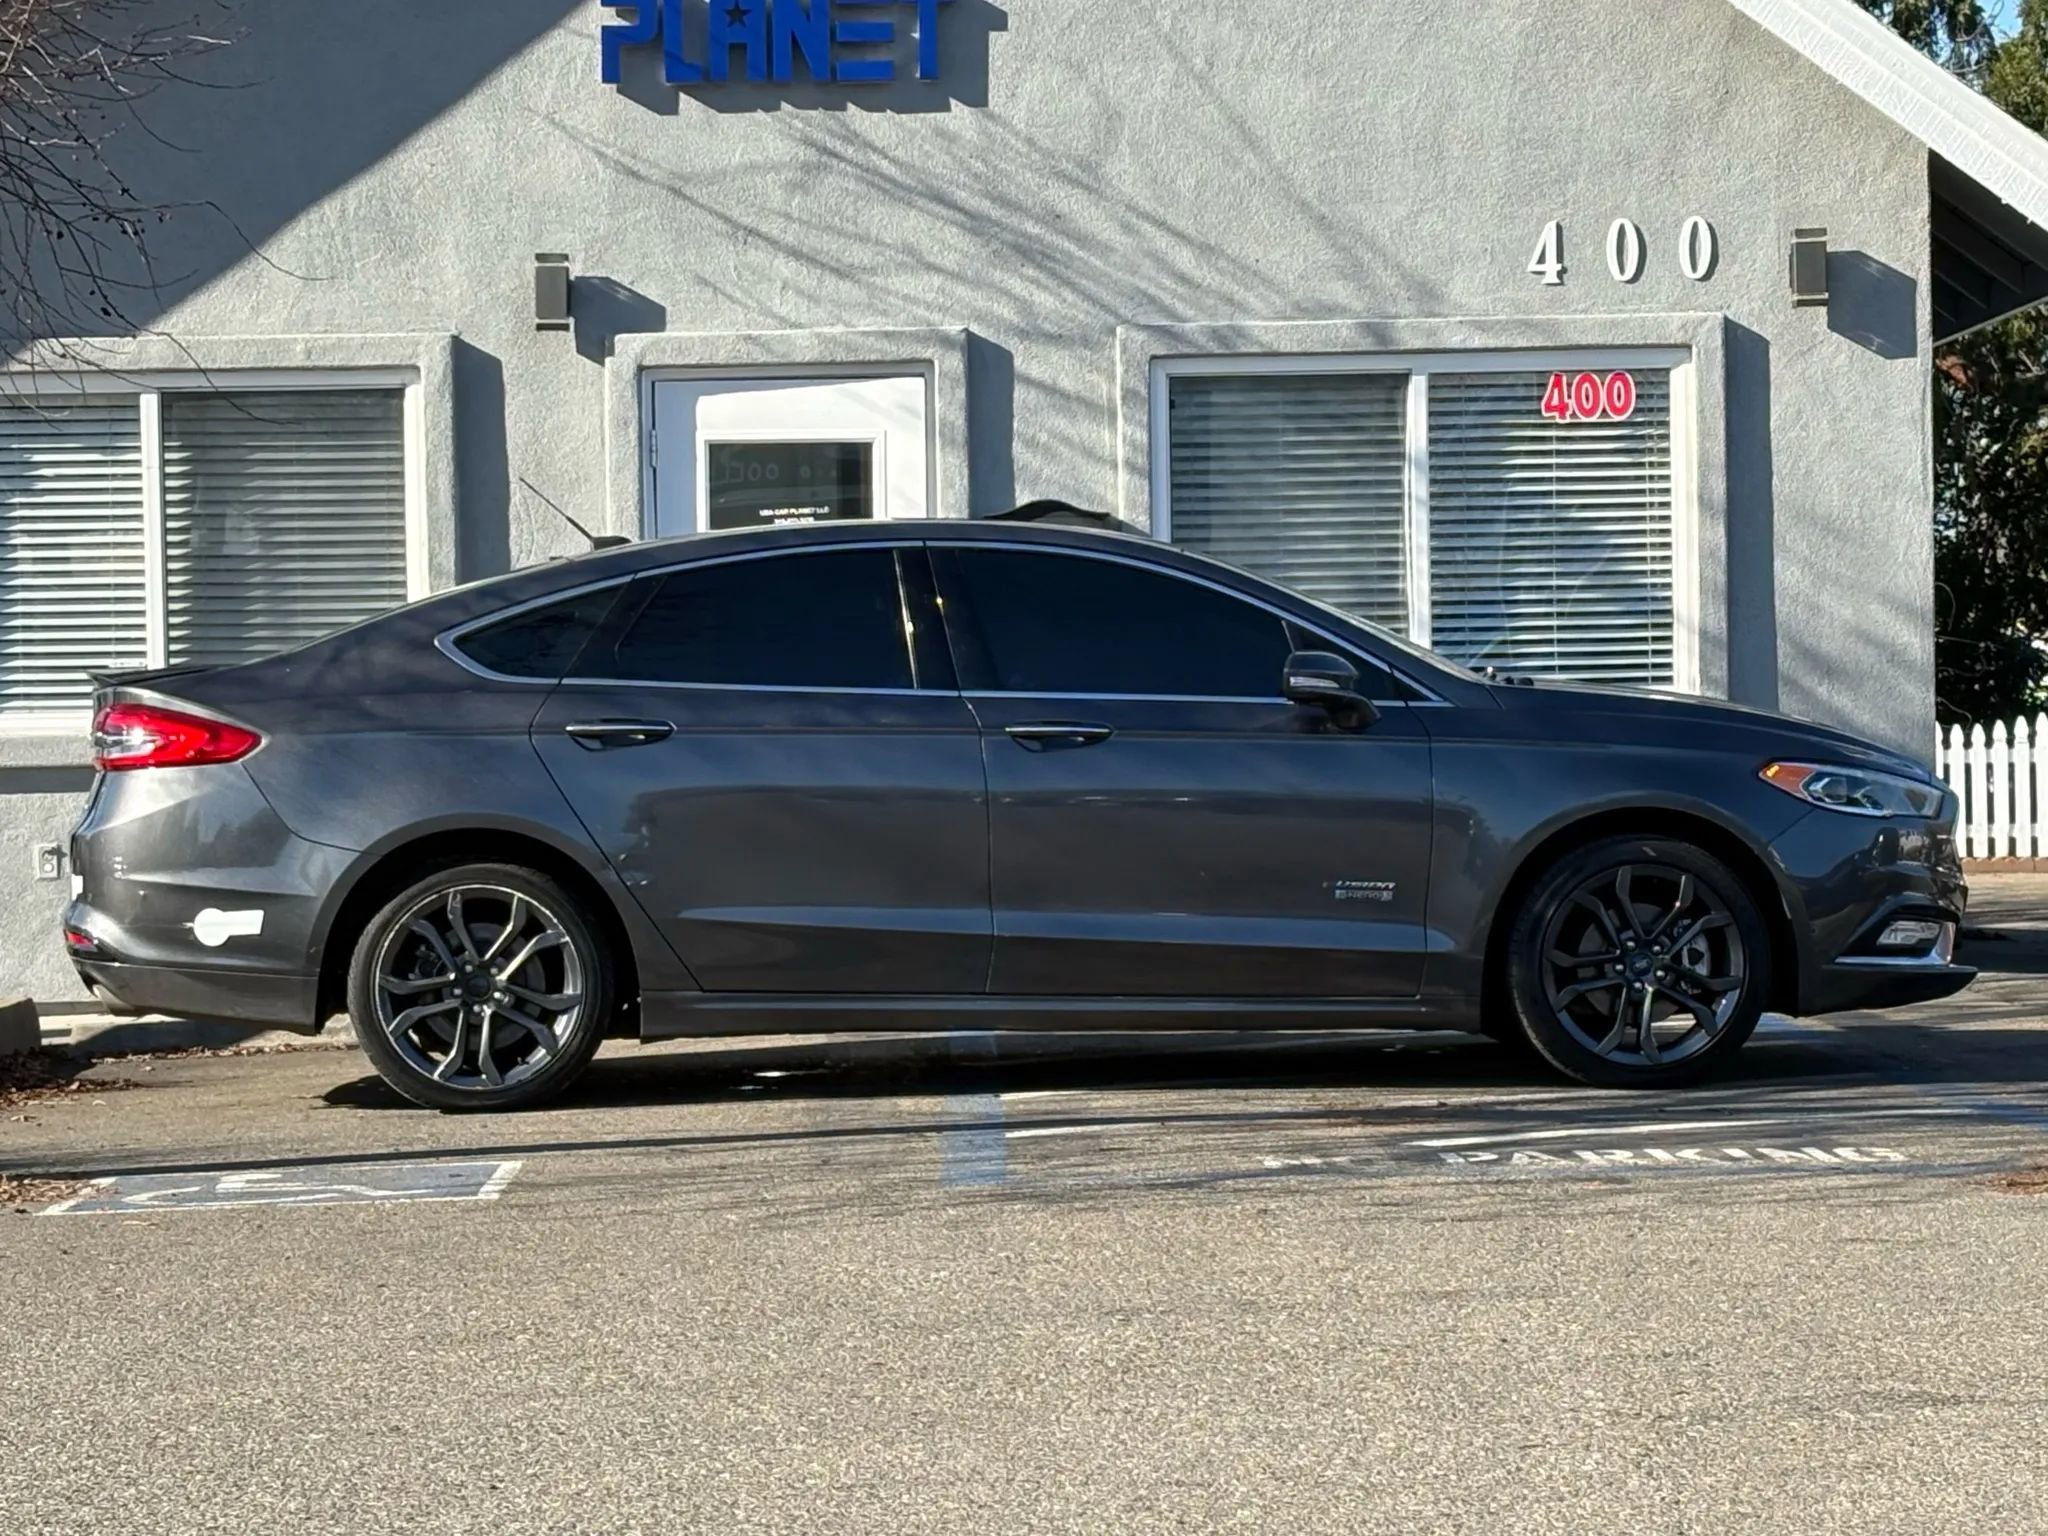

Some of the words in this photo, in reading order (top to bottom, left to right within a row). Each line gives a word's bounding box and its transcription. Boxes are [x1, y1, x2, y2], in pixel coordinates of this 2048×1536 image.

[601, 0, 956, 83] PLANET
[1527, 215, 1713, 284] 400
[1541, 371, 1636, 423] 400
[1438, 1147, 1908, 1165] PARKING
